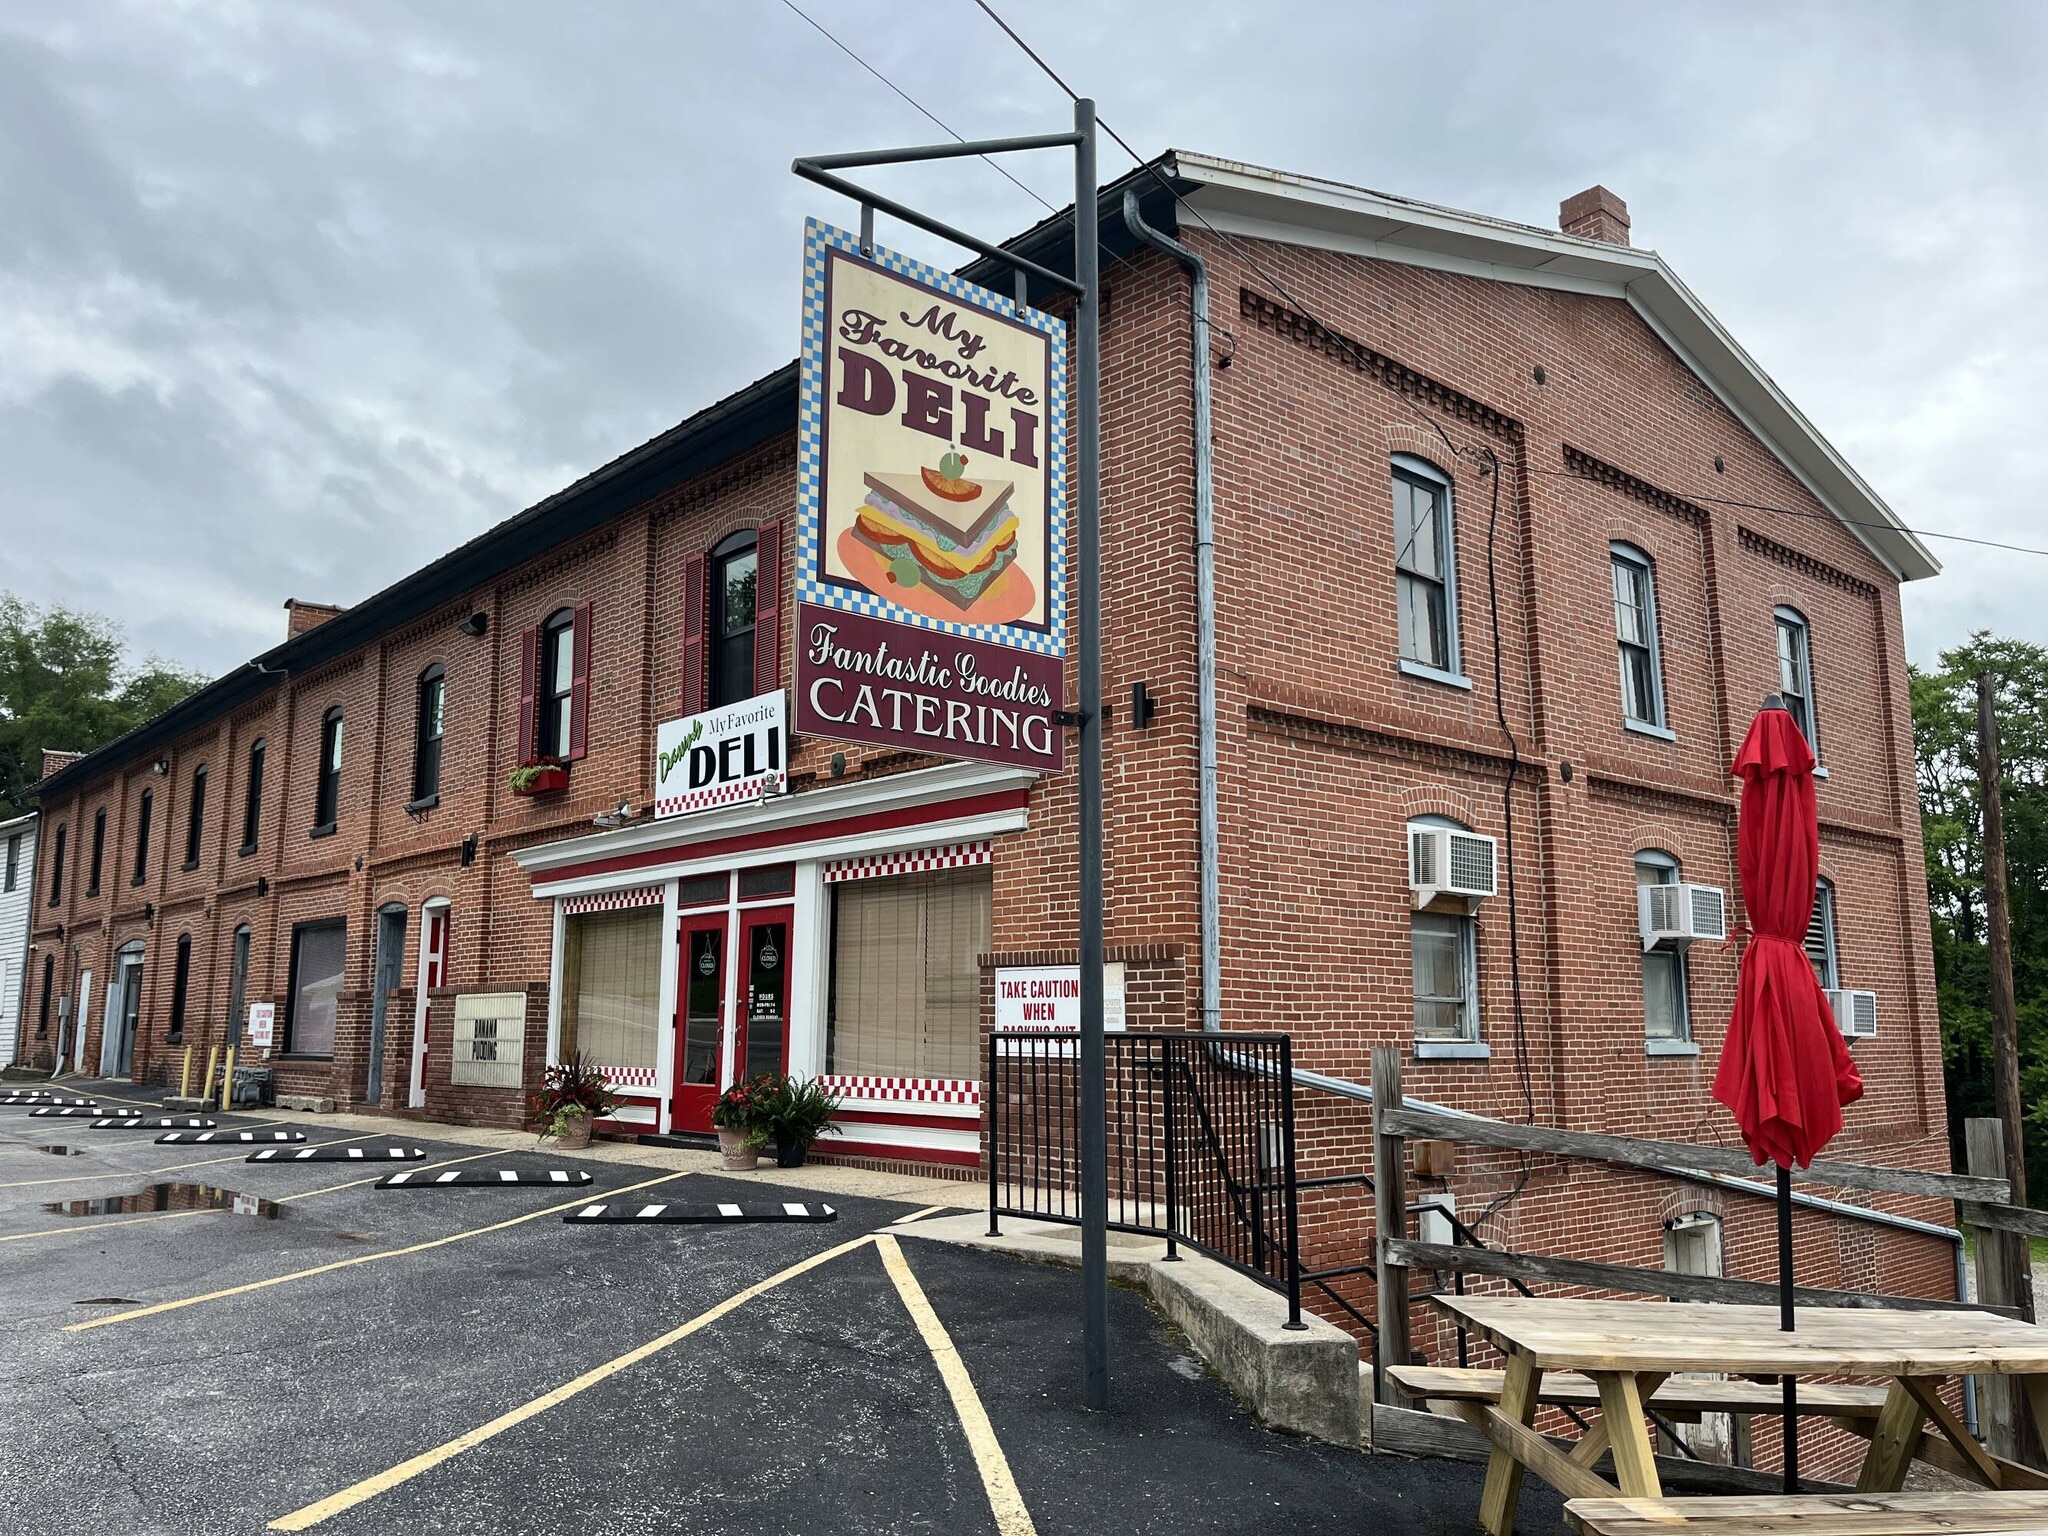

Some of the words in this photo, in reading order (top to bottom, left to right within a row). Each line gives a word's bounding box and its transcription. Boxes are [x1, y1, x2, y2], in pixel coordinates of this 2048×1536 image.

[839, 309, 1039, 405] Favorite
[900, 305, 987, 360] My
[837, 346, 1039, 469] DELI
[808, 622, 953, 689] Fantastic
[954, 652, 1052, 707] Goodies
[709, 719, 727, 736] My
[727, 705, 775, 730] Favorite
[809, 677, 1054, 755] CATERING
[689, 726, 779, 789] DELI
[1000, 981, 1027, 998] TAKE
[1030, 980, 1079, 998] CAUTION
[1023, 1003, 1055, 1020] WHEN
